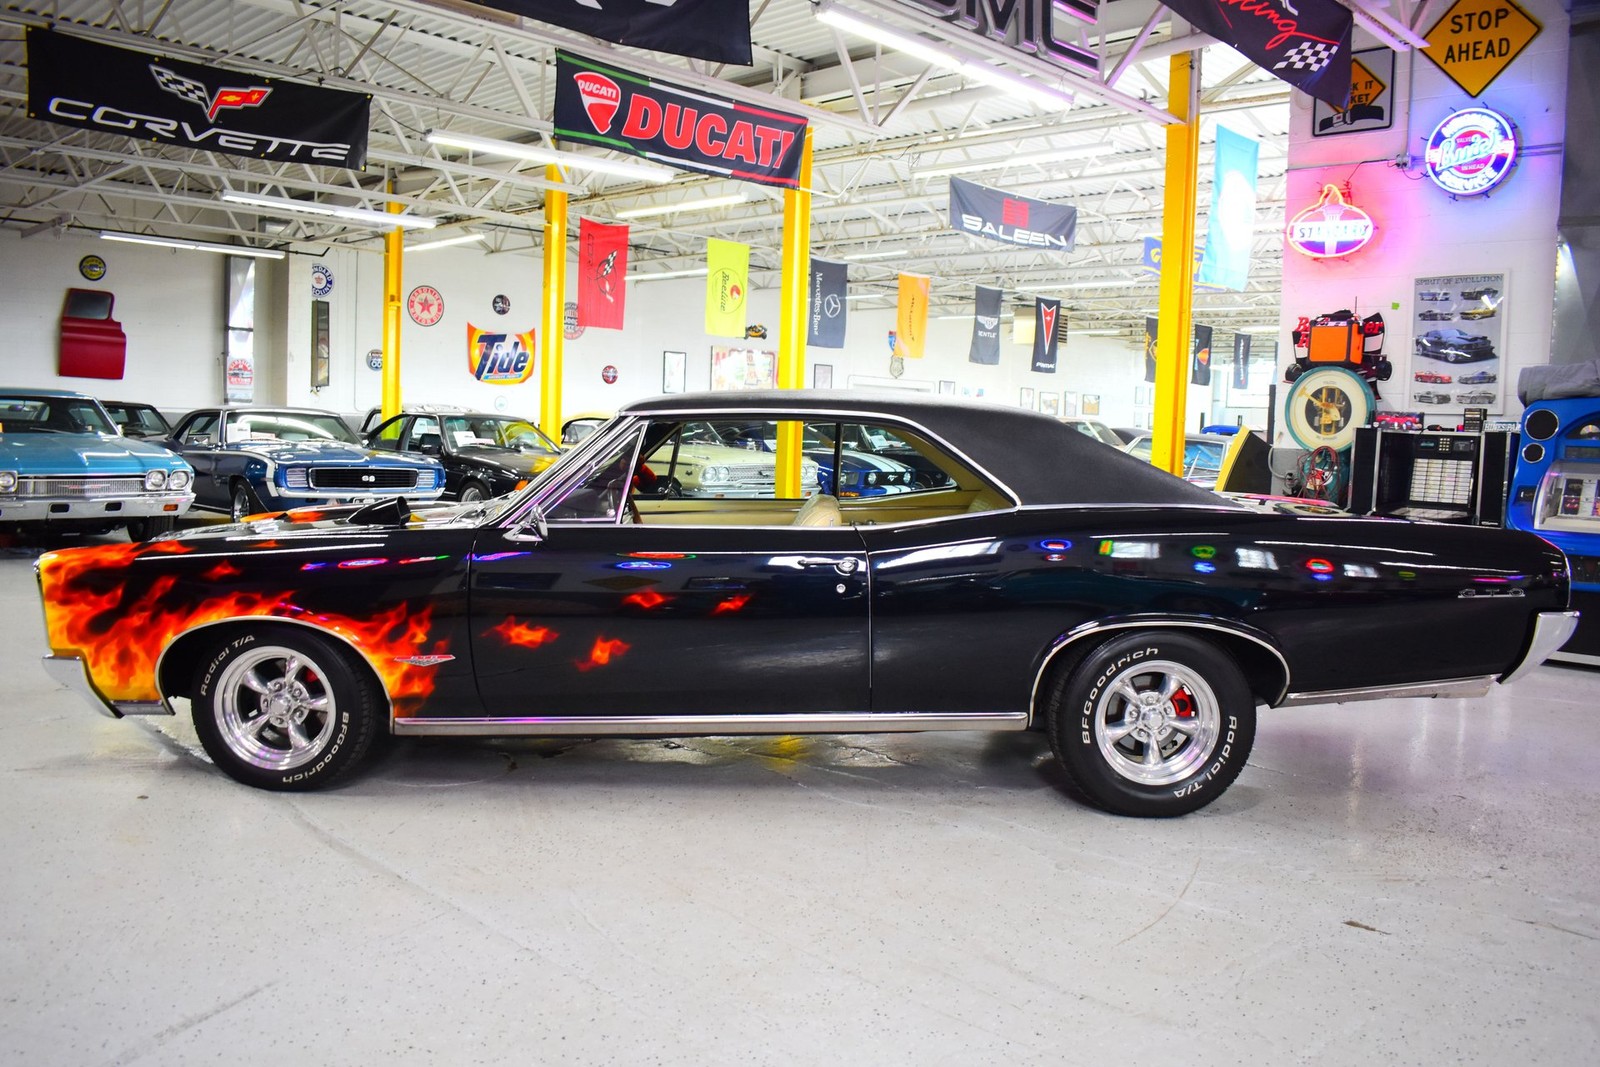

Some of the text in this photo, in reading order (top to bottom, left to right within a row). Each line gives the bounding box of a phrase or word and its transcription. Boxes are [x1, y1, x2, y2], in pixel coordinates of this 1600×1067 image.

[897, 0, 1101, 77] MC
[1450, 7, 1511, 34] STOP
[1443, 37, 1511, 64] AHEAD
[577, 78, 617, 99] DUCATI
[1364, 80, 1374, 90] IT
[49, 97, 351, 161] CORVETTE
[621, 93, 795, 169] DUCATI
[961, 213, 1067, 247] SALEEN
[1415, 275, 1504, 286] SPIRIT OF EVOLUTION
[475, 333, 530, 381] Tide
[200, 634, 256, 696] Radial T/A
[1081, 647, 1159, 745] BFGoodrich
[282, 711, 350, 783] BFGoodrich
[1173, 715, 1238, 799] Radial T/A
